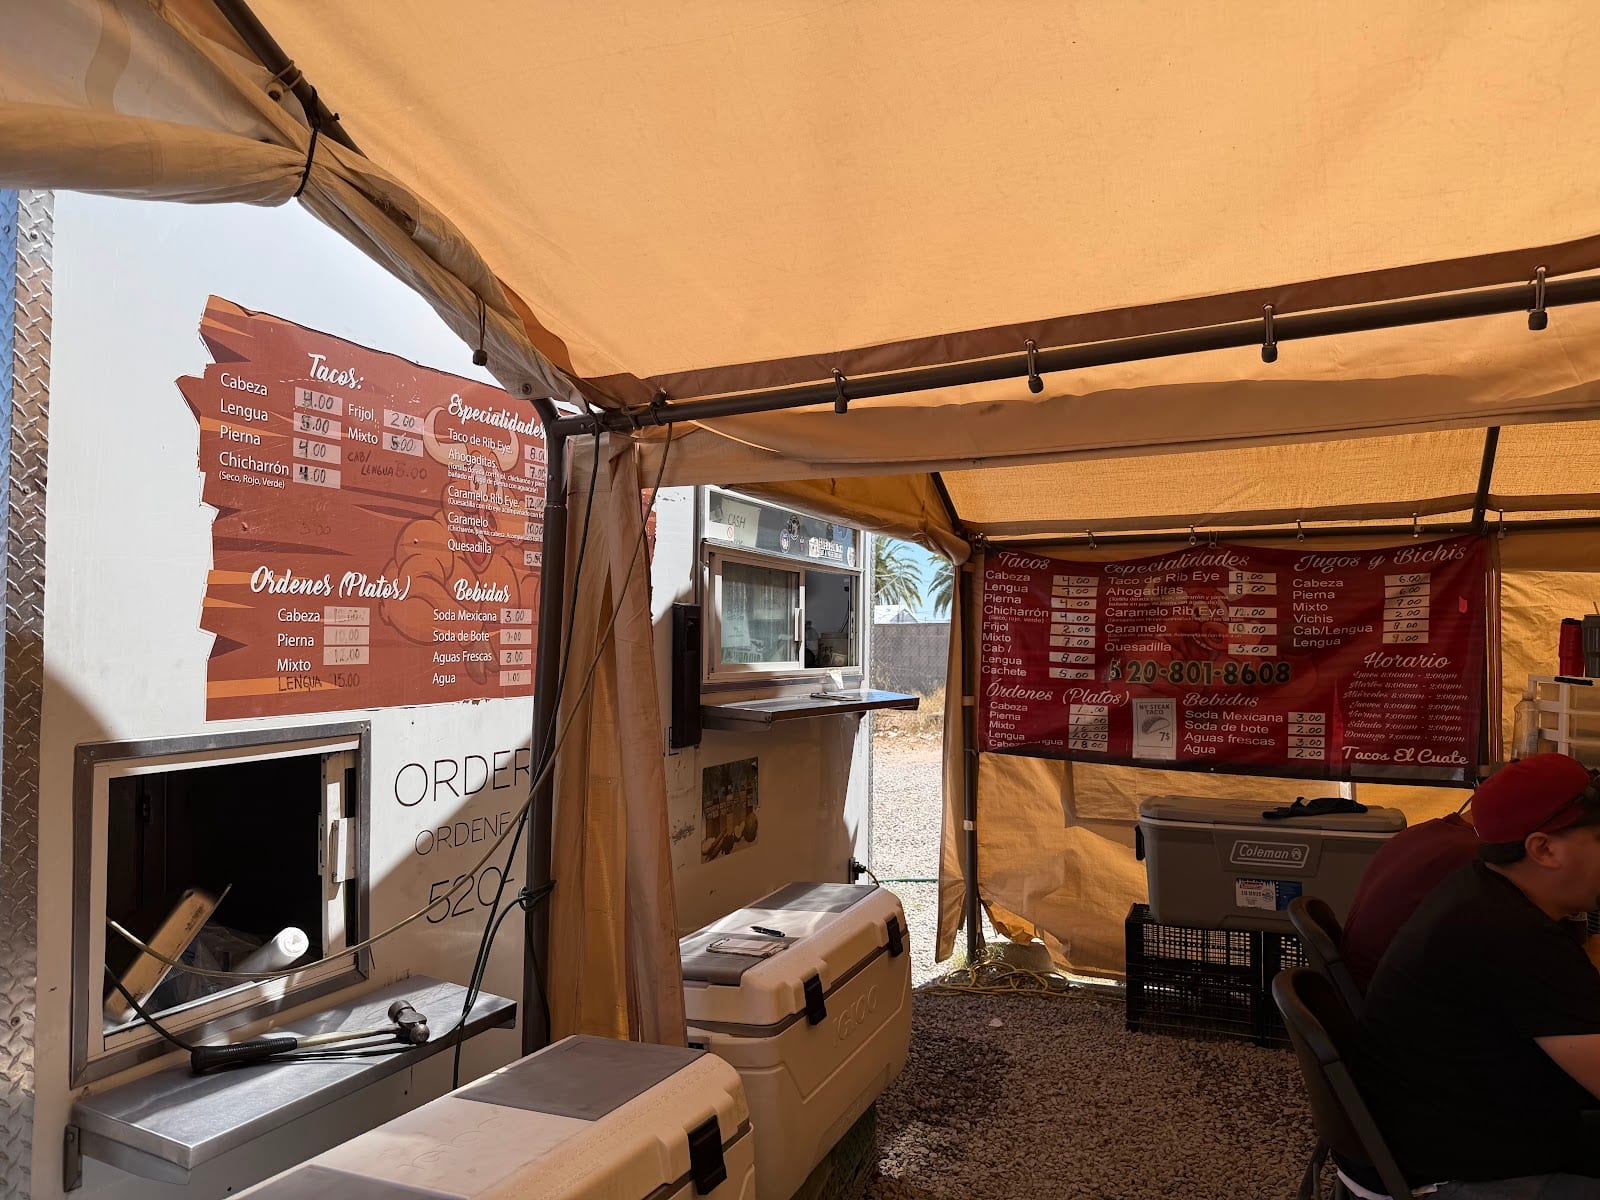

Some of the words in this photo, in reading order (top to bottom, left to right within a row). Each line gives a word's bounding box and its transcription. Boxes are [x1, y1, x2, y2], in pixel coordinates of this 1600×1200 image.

[308, 352, 364, 389] Tacos:
[220, 373, 268, 396] Cabeza
[220, 398, 268, 421] Lengua
[447, 394, 546, 439] Especialidades
[219, 425, 261, 445] Pierna
[348, 427, 378, 445] Mixto
[448, 428, 468, 443] Taco
[470, 433, 481, 445] de
[483, 436, 496, 448] Rib
[219, 451, 289, 476] Chicharrón
[361, 465, 393, 476] LENGUA
[219, 471, 241, 483] (Seco,
[243, 476, 262, 488] Rojo,
[263, 477, 285, 489] Verde)
[448, 486, 488, 502] Caramelo
[490, 492, 503, 505] Rib
[448, 512, 488, 527] Caramelo
[728, 513, 746, 528] CASH
[447, 539, 491, 555] Quesadilla
[999, 551, 1051, 570] Tacos
[1104, 551, 1250, 576] Especialidades
[1294, 554, 1361, 574] Jugos
[1368, 555, 1386, 570] y
[1393, 544, 1467, 565] Bichis
[250, 565, 334, 596] Ordenes
[339, 571, 411, 600] (Platos)
[985, 570, 1031, 581] Cabeza
[1062, 576, 1090, 585] 4.00
[1108, 577, 1140, 585] Taco
[1144, 575, 1161, 584] de
[1166, 573, 1188, 582] Rib
[1192, 571, 1220, 582] Eye
[1292, 578, 1344, 588] Cabeza
[454, 578, 511, 603] Bebidas
[984, 581, 1029, 594] Lengua
[1106, 586, 1184, 597] Ahogaditas
[983, 593, 1022, 604] Pierna
[1292, 590, 1336, 600] Pierna
[983, 605, 1049, 617] Chicharrón
[1105, 607, 1168, 617] Caramelo
[1173, 606, 1194, 616] Rib
[1200, 607, 1224, 617] Eye
[1292, 602, 1329, 612] Mixto
[278, 608, 320, 622] Cabeza
[433, 609, 455, 620] Soda
[458, 610, 497, 621] Mexicana
[505, 611, 524, 622] 3.00
[1293, 614, 1334, 624] Vichis
[983, 622, 1009, 632] Frijol
[1063, 625, 1090, 634] 2.00
[1105, 624, 1167, 633] Caramelo
[1233, 624, 1266, 633] 10.00
[1293, 624, 1373, 636] Cab/Lengua
[277, 633, 314, 647] Pierna
[433, 630, 455, 641] Soda
[458, 631, 468, 641] de
[471, 631, 489, 641] Bote
[982, 632, 1012, 642] Mixto
[1063, 637, 1090, 647] 7.00
[982, 643, 1005, 653] Cab
[1105, 643, 1172, 652] Quesadilla
[1236, 645, 1269, 653] 5.00
[1293, 638, 1341, 649] Lengua
[277, 658, 311, 671] Mixto
[433, 652, 460, 665] Aguas
[463, 651, 492, 661] Frescas
[982, 654, 1022, 666] Lengua
[1061, 653, 1089, 663] 8.00
[1364, 651, 1452, 669] Horario
[981, 665, 1027, 677] Cachete
[1059, 669, 1089, 679] 5.00
[278, 674, 322, 692] LENGUA
[432, 673, 455, 686] Agua
[1062, 687, 1130, 707] (Platos)
[1182, 691, 1260, 707] Bebidas
[990, 701, 1028, 712] Cabeza
[989, 711, 1021, 721] Pierna
[1184, 710, 1219, 720] Soda
[1222, 711, 1283, 723] Mexicana
[1296, 713, 1322, 722] 3.00
[989, 720, 1016, 730] Mixto
[1184, 720, 1218, 731] Soda
[1221, 723, 1237, 732] de
[1240, 724, 1269, 734] bote
[1296, 726, 1322, 734] 2.00
[988, 730, 1025, 741] Lengua
[1183, 732, 1224, 743] Aguas
[1228, 734, 1276, 746] frescas
[1183, 744, 1216, 755] Agua
[1295, 749, 1322, 758] 2.00
[1341, 746, 1391, 761] Tacos
[1393, 747, 1415, 762] El
[1417, 748, 1470, 764] Cuate
[1239, 844, 1289, 859] Coleman
